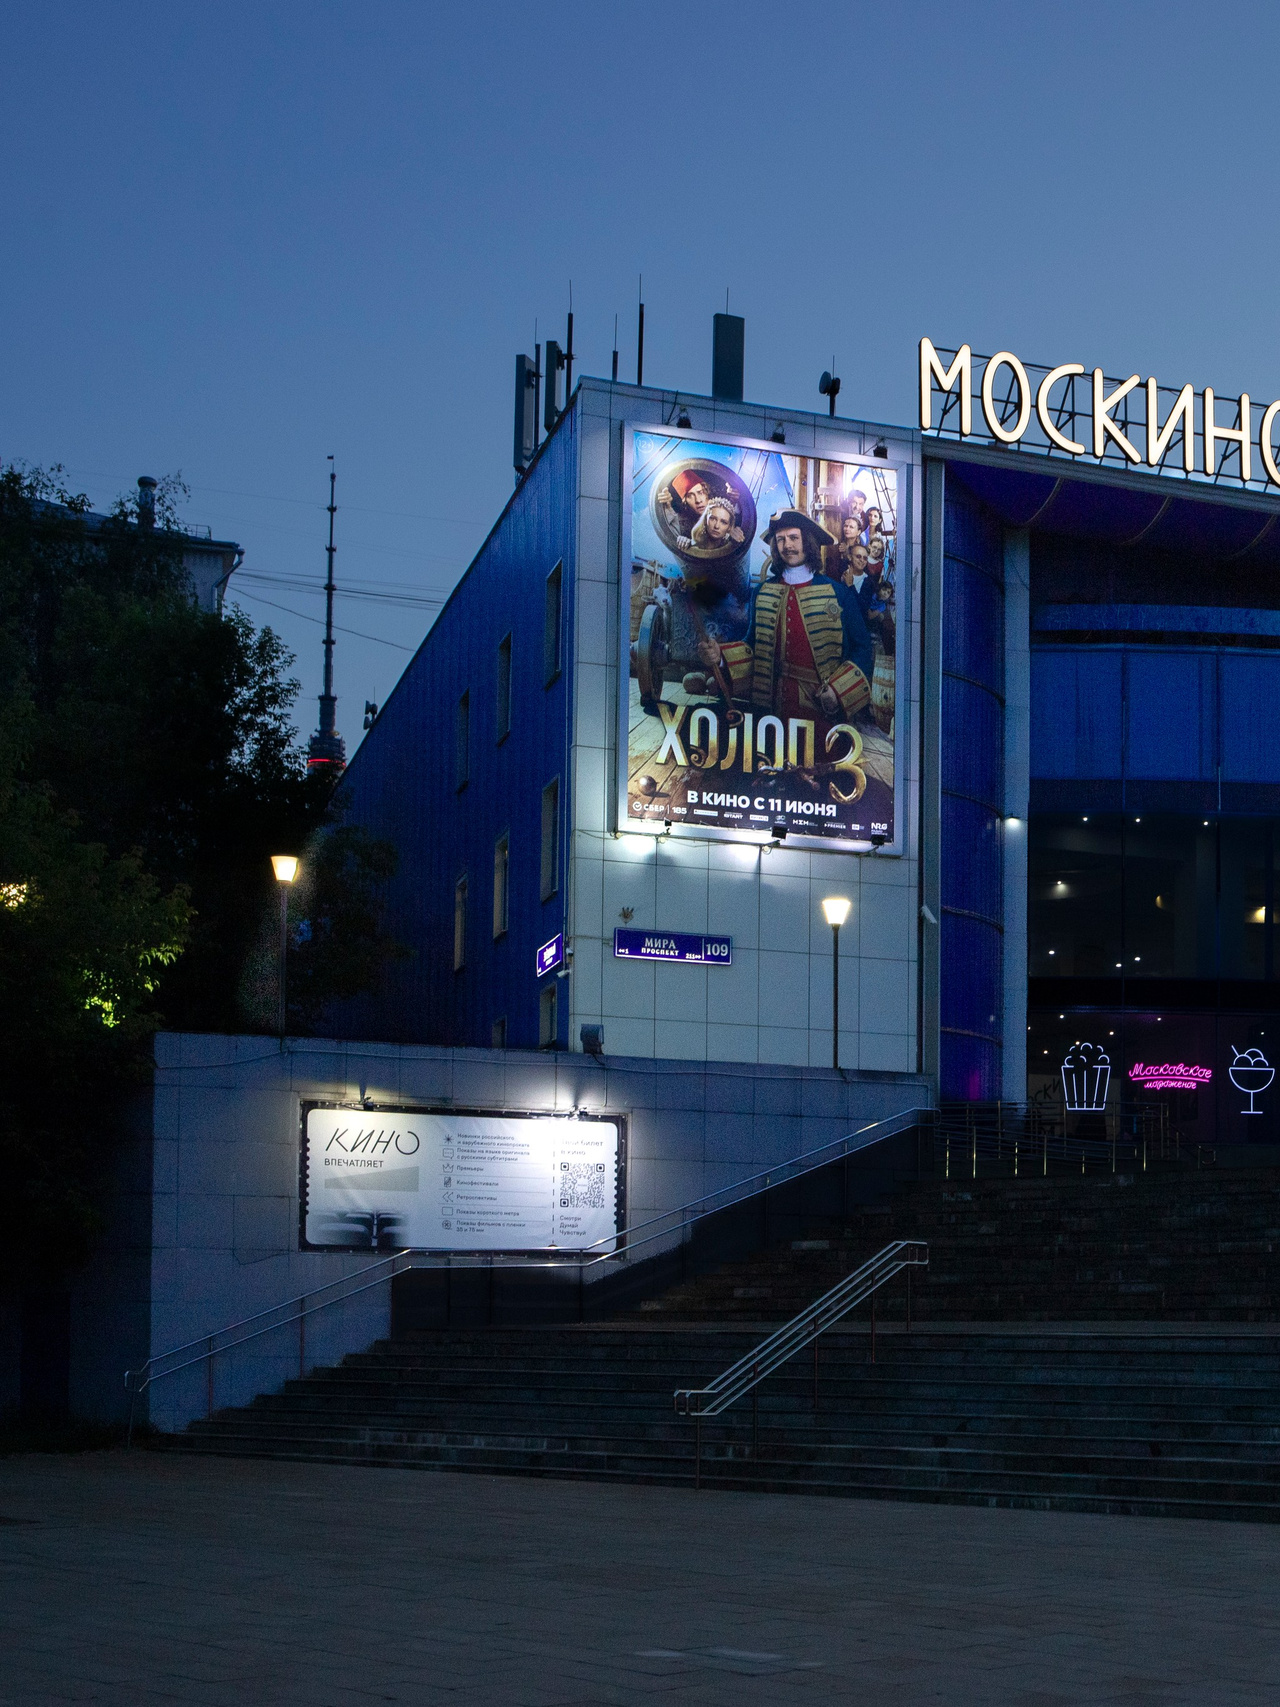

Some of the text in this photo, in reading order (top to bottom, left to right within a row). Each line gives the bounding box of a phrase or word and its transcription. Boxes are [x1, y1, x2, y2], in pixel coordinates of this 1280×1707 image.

[655, 701, 867, 804] ХОЛОП 3
[643, 804, 665, 812] СБЕР
[687, 790, 837, 817] В КИНО С 11 ИЮНЯ
[644, 937, 676, 949] МИРА
[641, 947, 679, 956] ПРОСПЕКТ
[706, 944, 728, 956] 109
[1128, 1063, 1212, 1078] Московское
[1144, 1080, 1197, 1090] мороженое
[325, 1128, 420, 1155] КИНО
[324, 1158, 384, 1168] ВПЕЧАТЛЯЕТ
